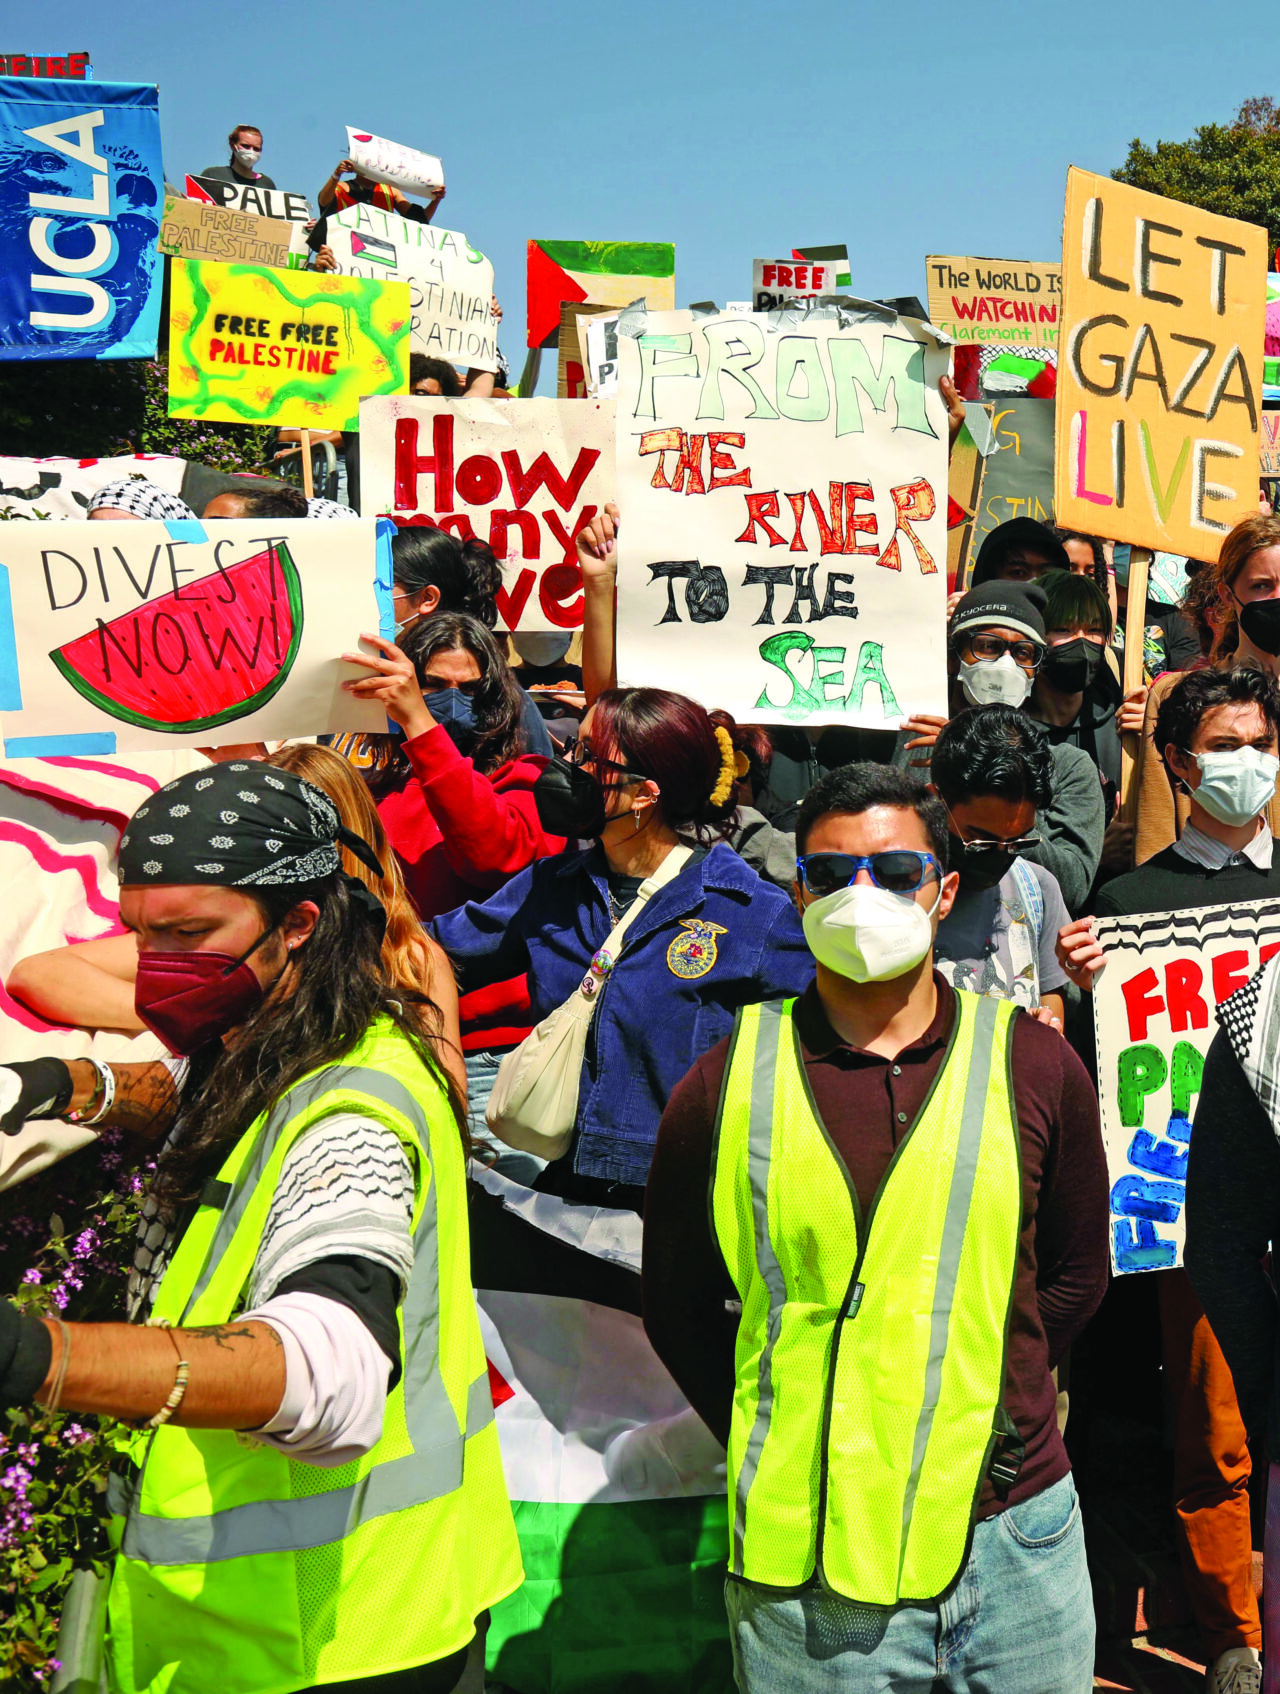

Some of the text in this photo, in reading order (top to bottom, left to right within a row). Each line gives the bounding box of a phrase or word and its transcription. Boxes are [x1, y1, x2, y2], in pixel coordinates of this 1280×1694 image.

[23, 109, 112, 330] UCLA
[162, 223, 291, 268] PALESTINE
[201, 207, 260, 236] FREE
[336, 203, 484, 264] LATINAS
[429, 258, 445, 283] 4
[762, 264, 825, 290] FREE
[932, 264, 970, 289] The
[975, 268, 1042, 293] WORLD
[1082, 197, 1246, 316] LET
[213, 313, 339, 347] FREE FREE
[951, 295, 1057, 323] WATCHIN
[209, 337, 340, 375] PALESTINE
[632, 318, 940, 440] FROM
[1067, 314, 1258, 433] GAZA
[394, 413, 601, 513] How
[631, 426, 752, 496] THE
[1069, 410, 1245, 537] LIVE
[735, 476, 938, 575] RIVER
[40, 536, 290, 611] DIVEST
[646, 558, 859, 627] TO THE
[95, 602, 283, 683] NOW!
[751, 630, 904, 721] SEA
